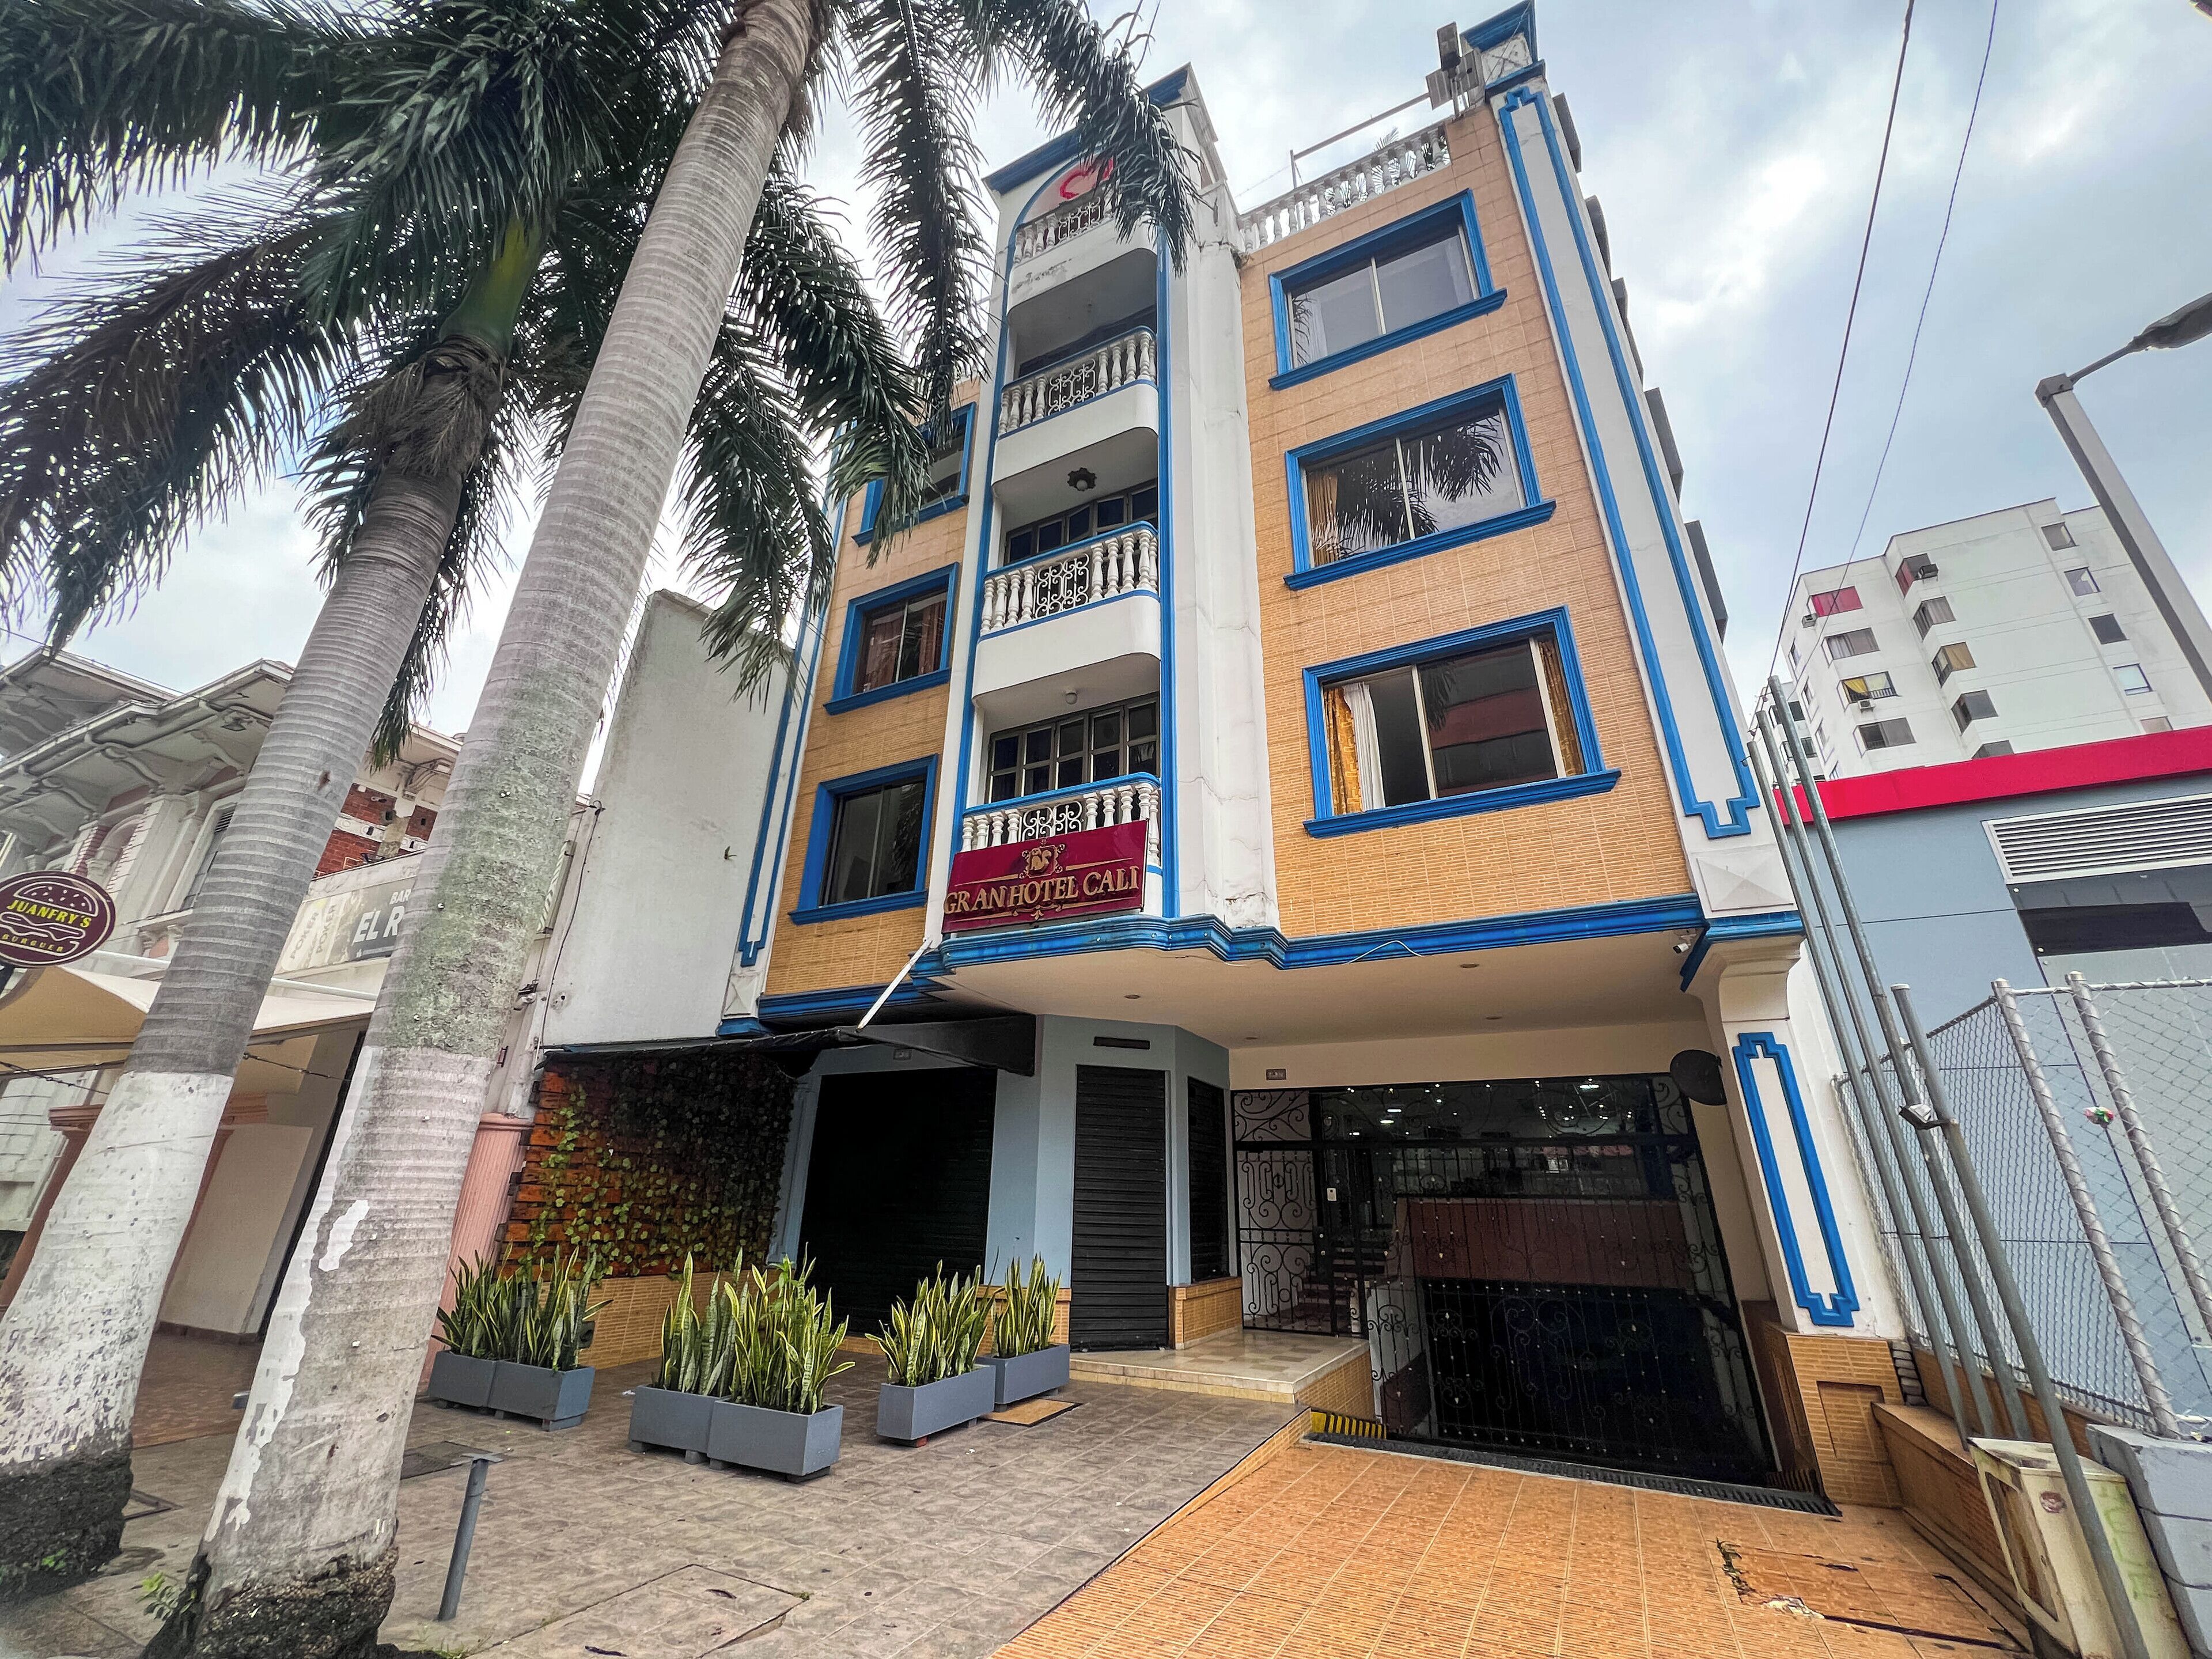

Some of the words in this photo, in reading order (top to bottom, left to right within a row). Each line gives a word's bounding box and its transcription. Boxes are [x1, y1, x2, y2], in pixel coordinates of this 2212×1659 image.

[390, 889, 412, 905] BAR
[945, 885, 1006, 914] GRAN
[1007, 876, 1079, 906] HOTEL
[1083, 866, 1139, 896] CALI
[353, 910, 381, 944] EL
[1, 934, 64, 953] BURGUER
